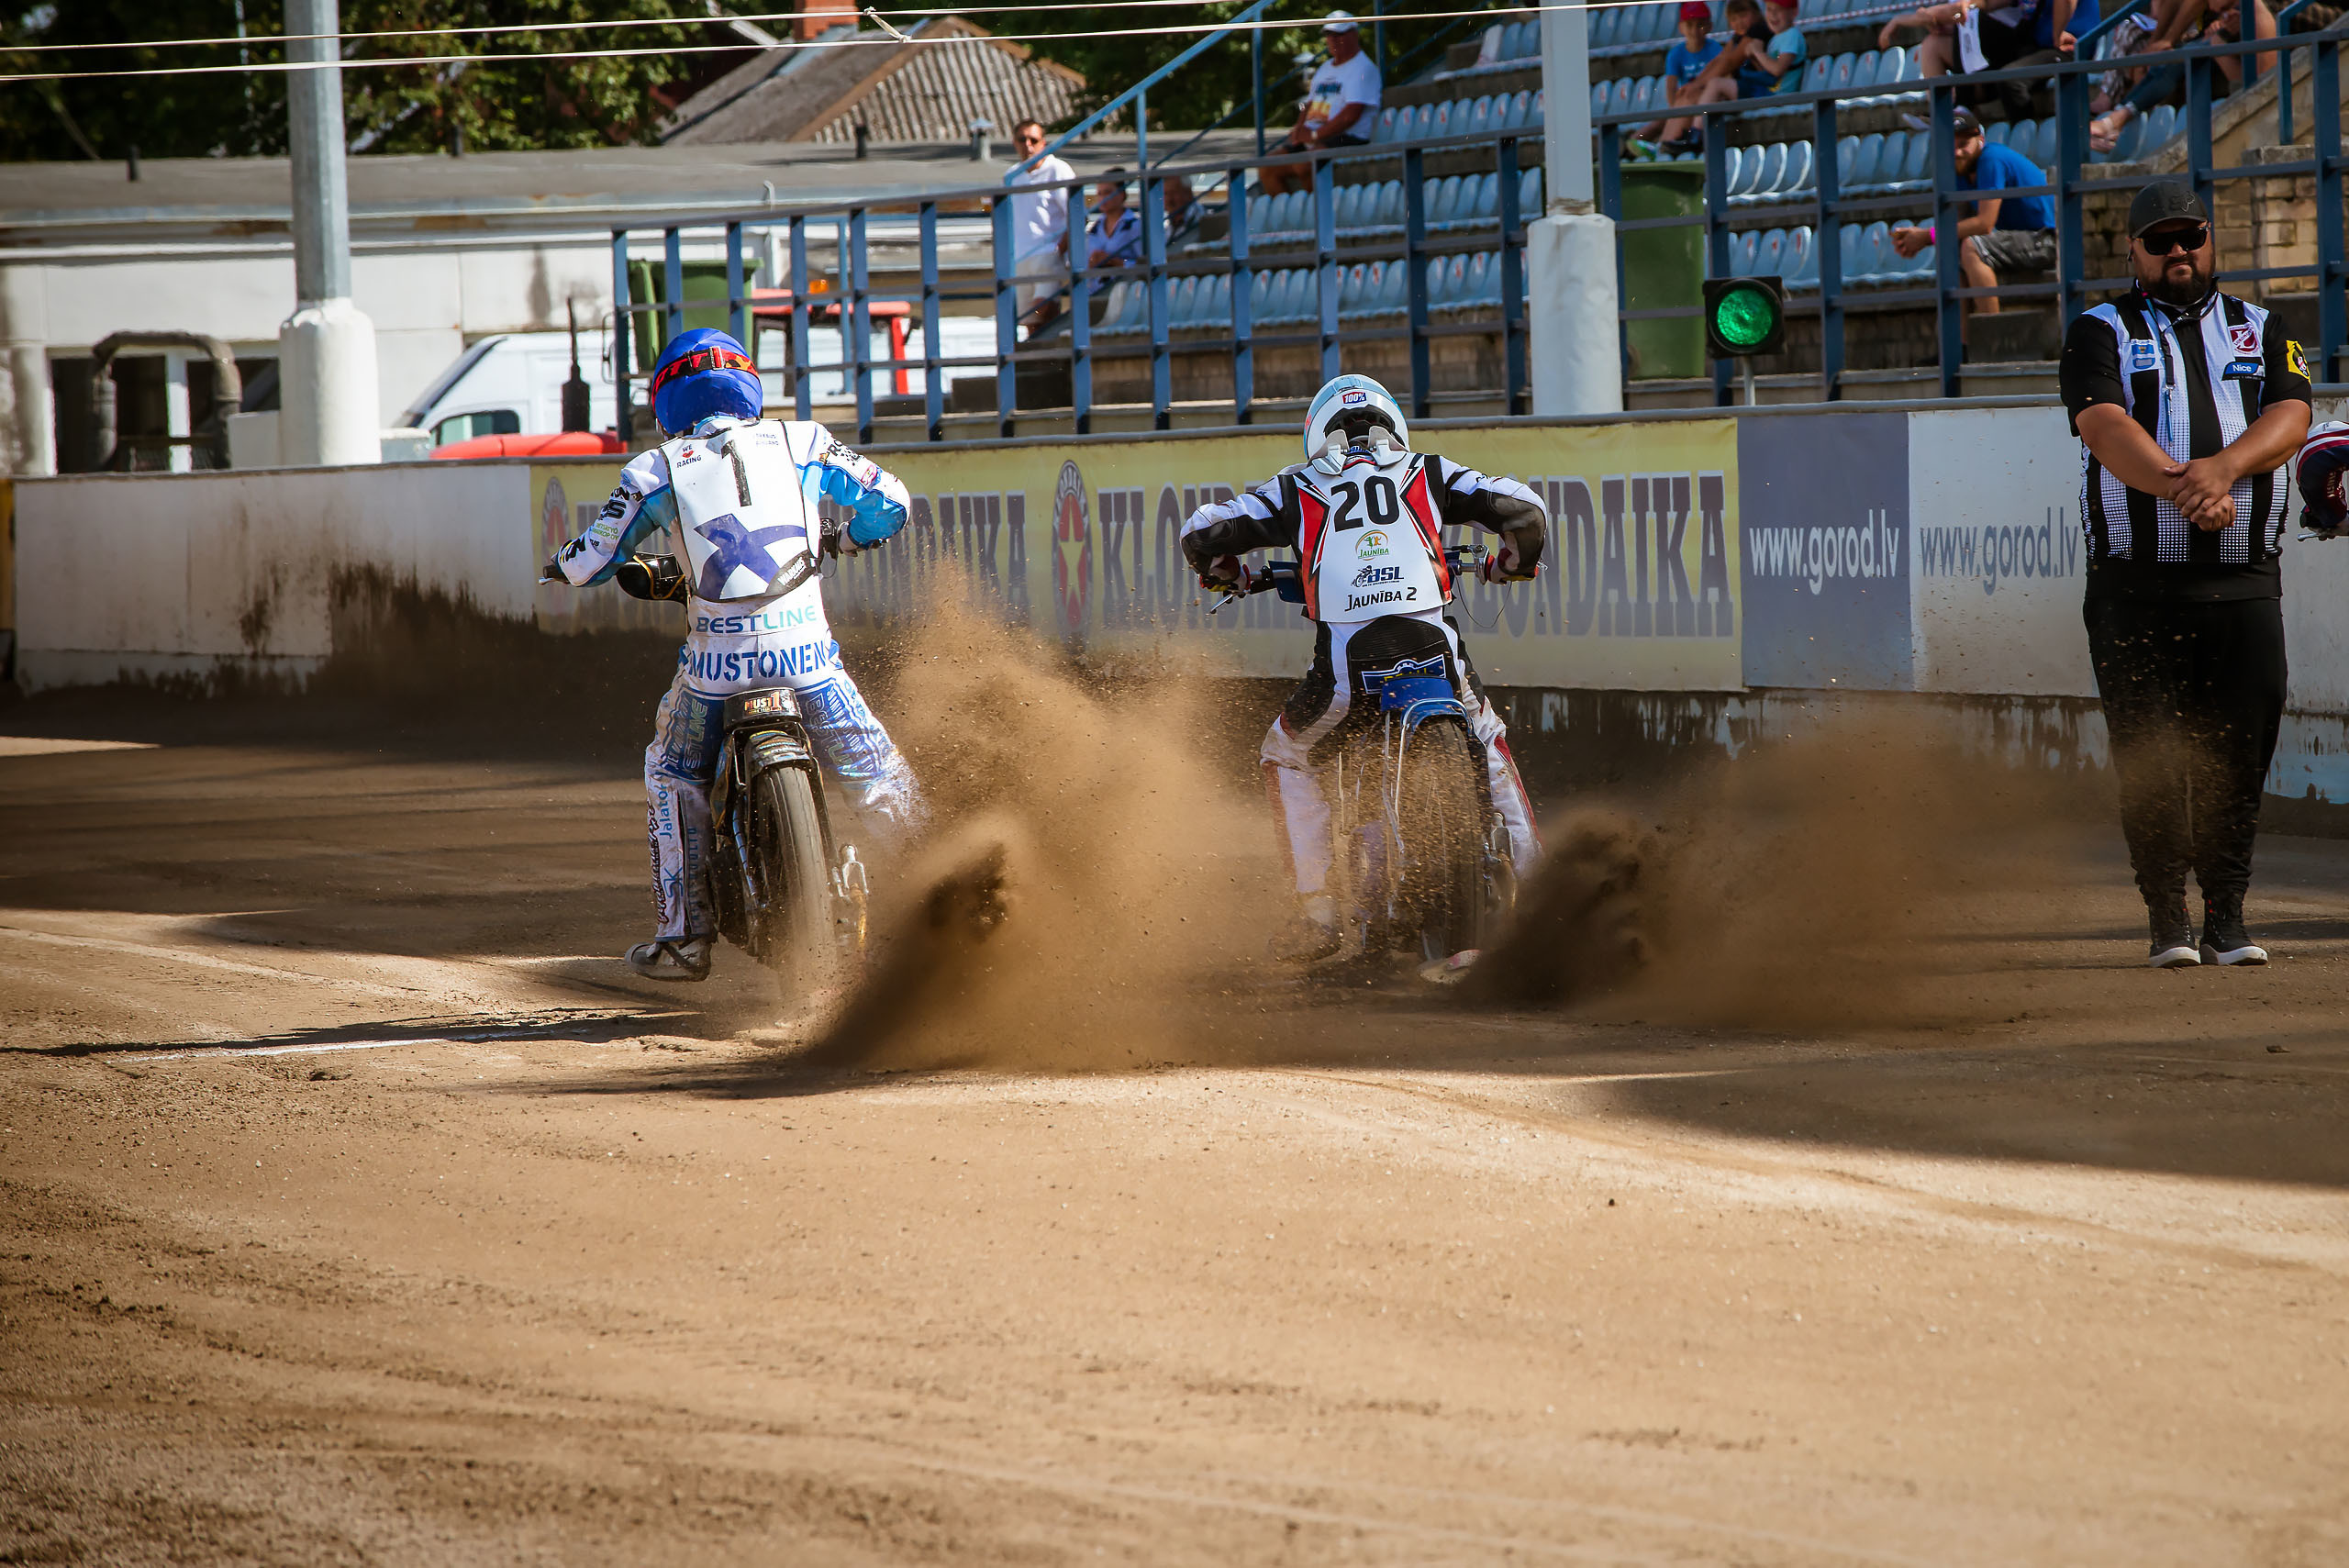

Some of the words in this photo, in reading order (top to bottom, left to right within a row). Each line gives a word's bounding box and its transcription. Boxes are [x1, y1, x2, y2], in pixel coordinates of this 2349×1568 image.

[2232, 364, 2252, 373] Nice
[1344, 393, 1365, 404] 100%
[676, 455, 702, 468] RACING
[682, 444, 693, 452] WE
[720, 439, 752, 507] 1
[1330, 475, 1400, 533] 20
[1749, 508, 1899, 595] www.gorod.lv
[1920, 506, 2079, 595] www.gorod.lv
[1344, 590, 1402, 612] JAUNĪBA
[1406, 587, 1418, 601] 2
[696, 605, 818, 634] BESTLINE
[688, 640, 829, 681] MUSTONEN
[684, 697, 709, 775] ESTLINE
